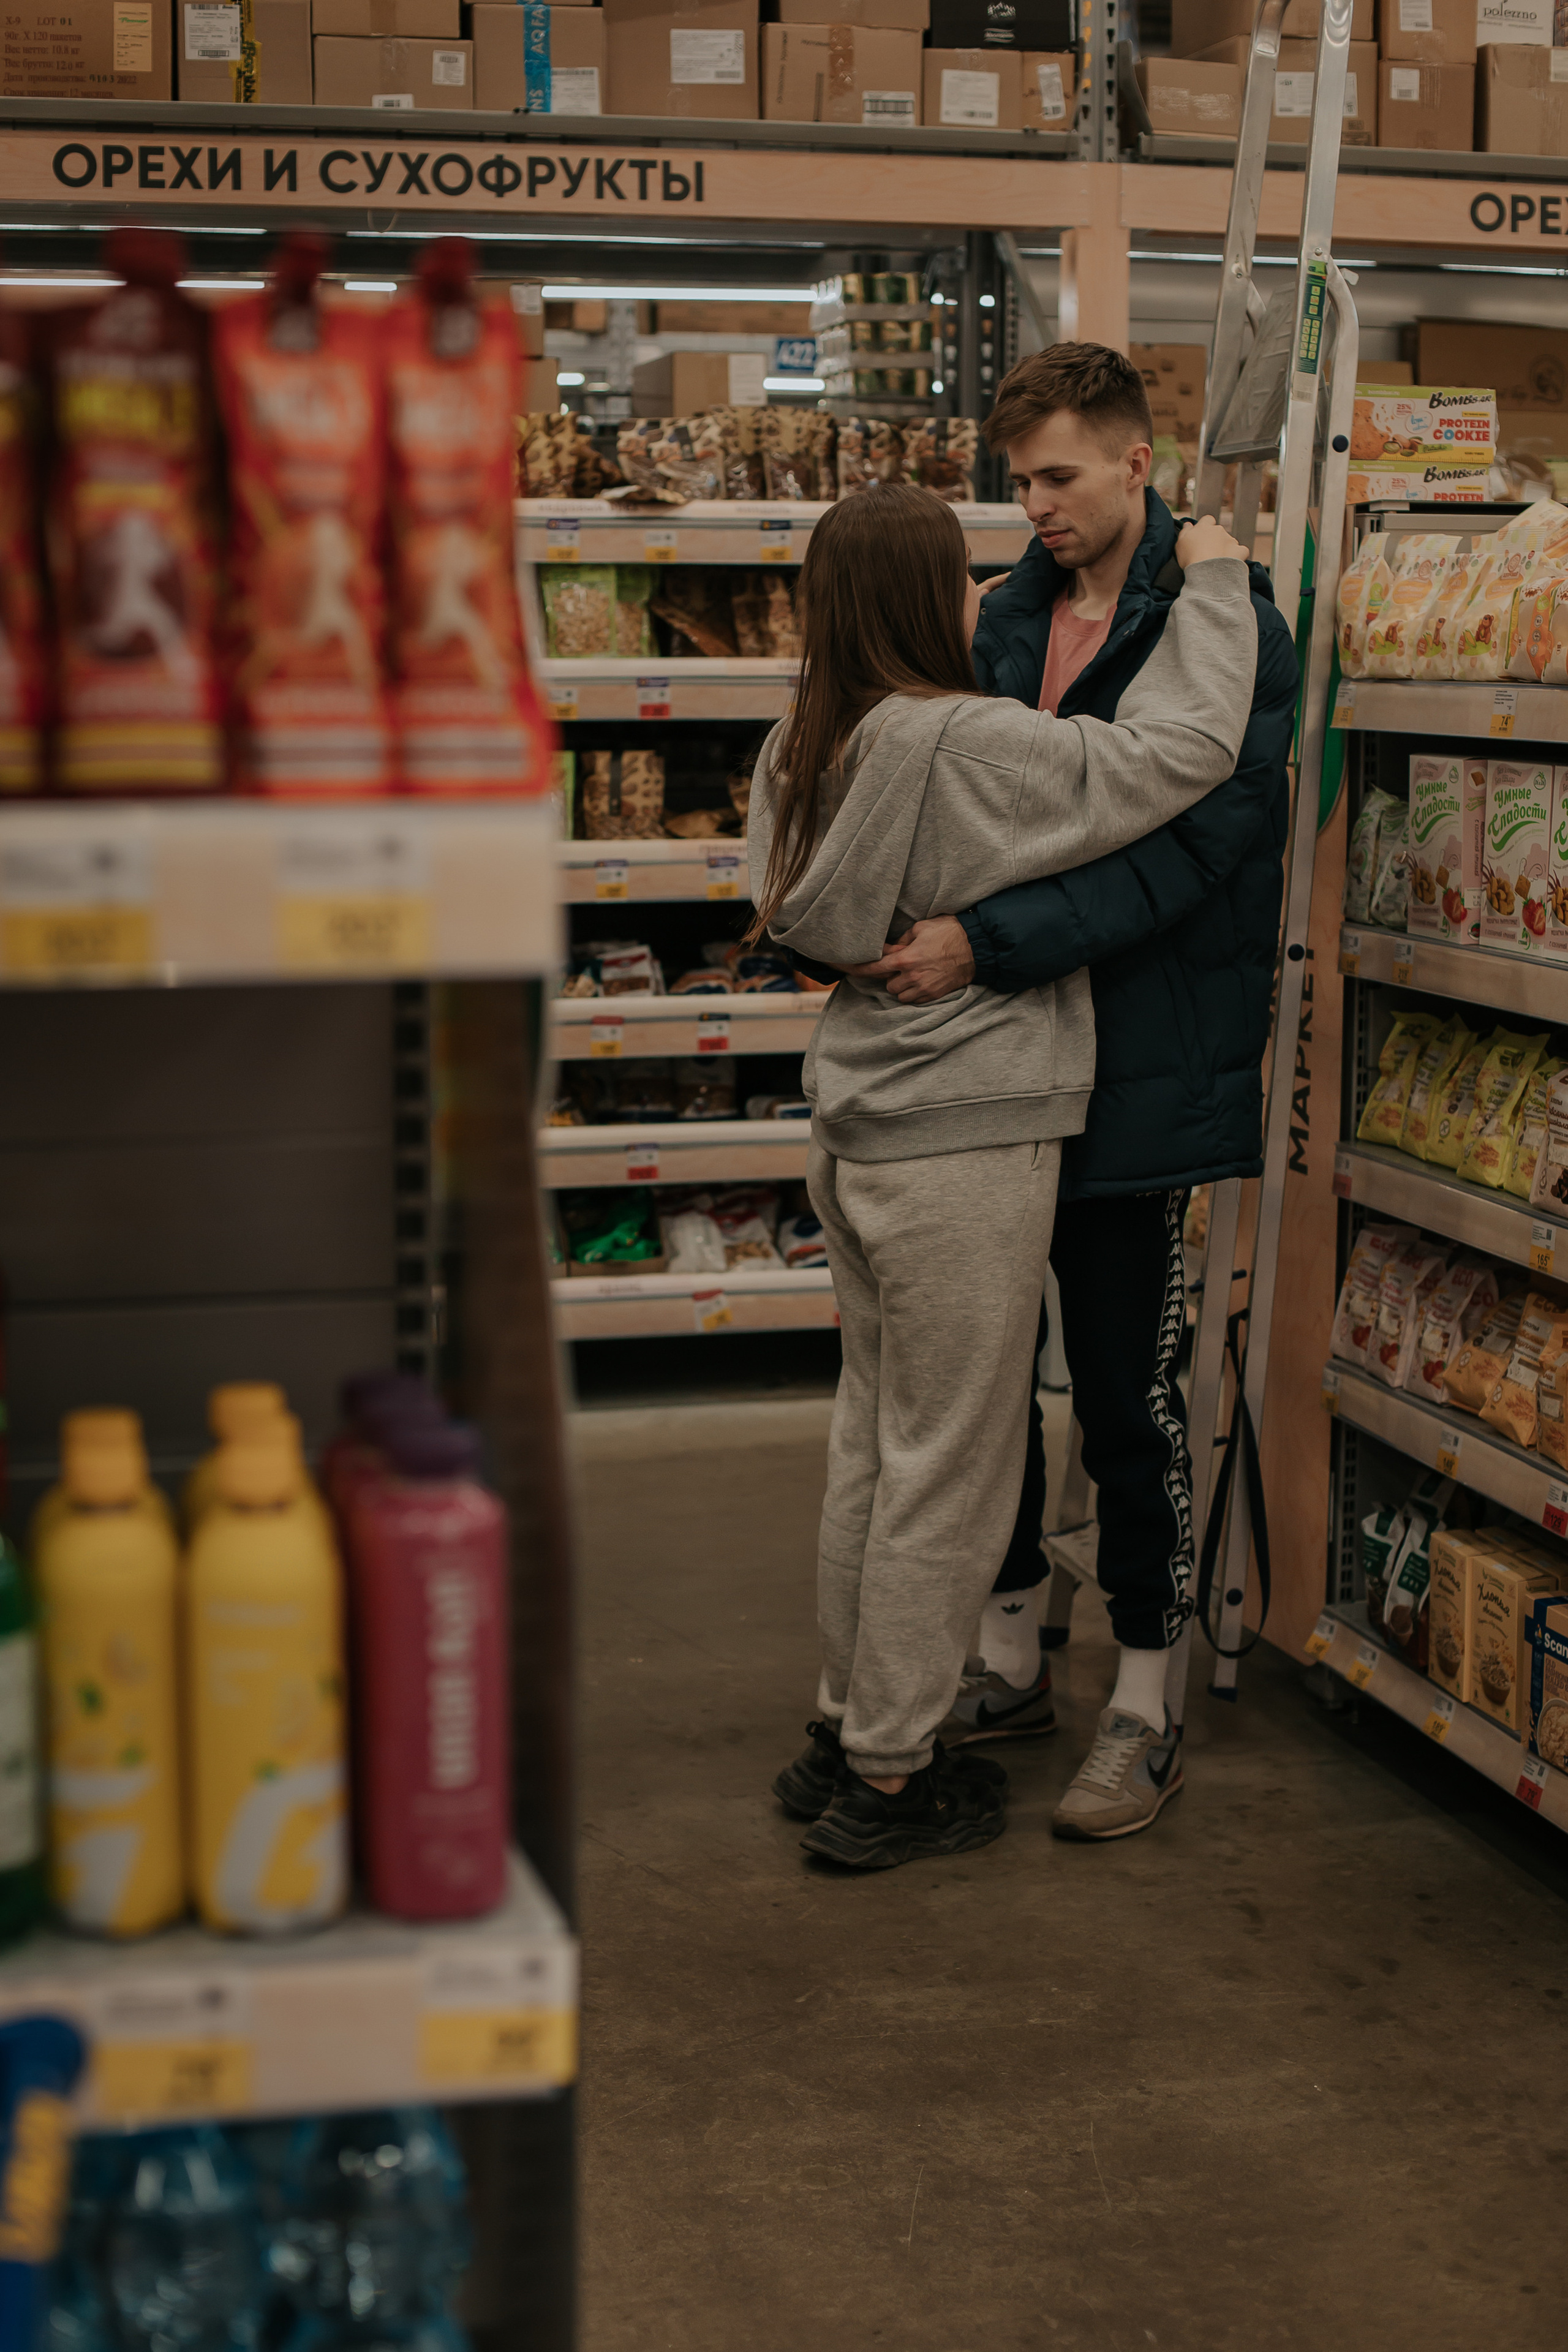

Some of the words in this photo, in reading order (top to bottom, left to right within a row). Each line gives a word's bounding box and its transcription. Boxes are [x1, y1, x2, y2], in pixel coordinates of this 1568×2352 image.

[37, 16, 56, 26] LOT
[52, 143, 241, 190] ОРЕХИ
[264, 149, 297, 192] И
[320, 150, 703, 202] СУХОФРУКТЫ
[1470, 192, 1568, 235] ОРЕ
[1439, 418, 1490, 429] PROTEIN
[1433, 429, 1490, 441] COOKIE
[1433, 492, 1484, 502] PROTEIN
